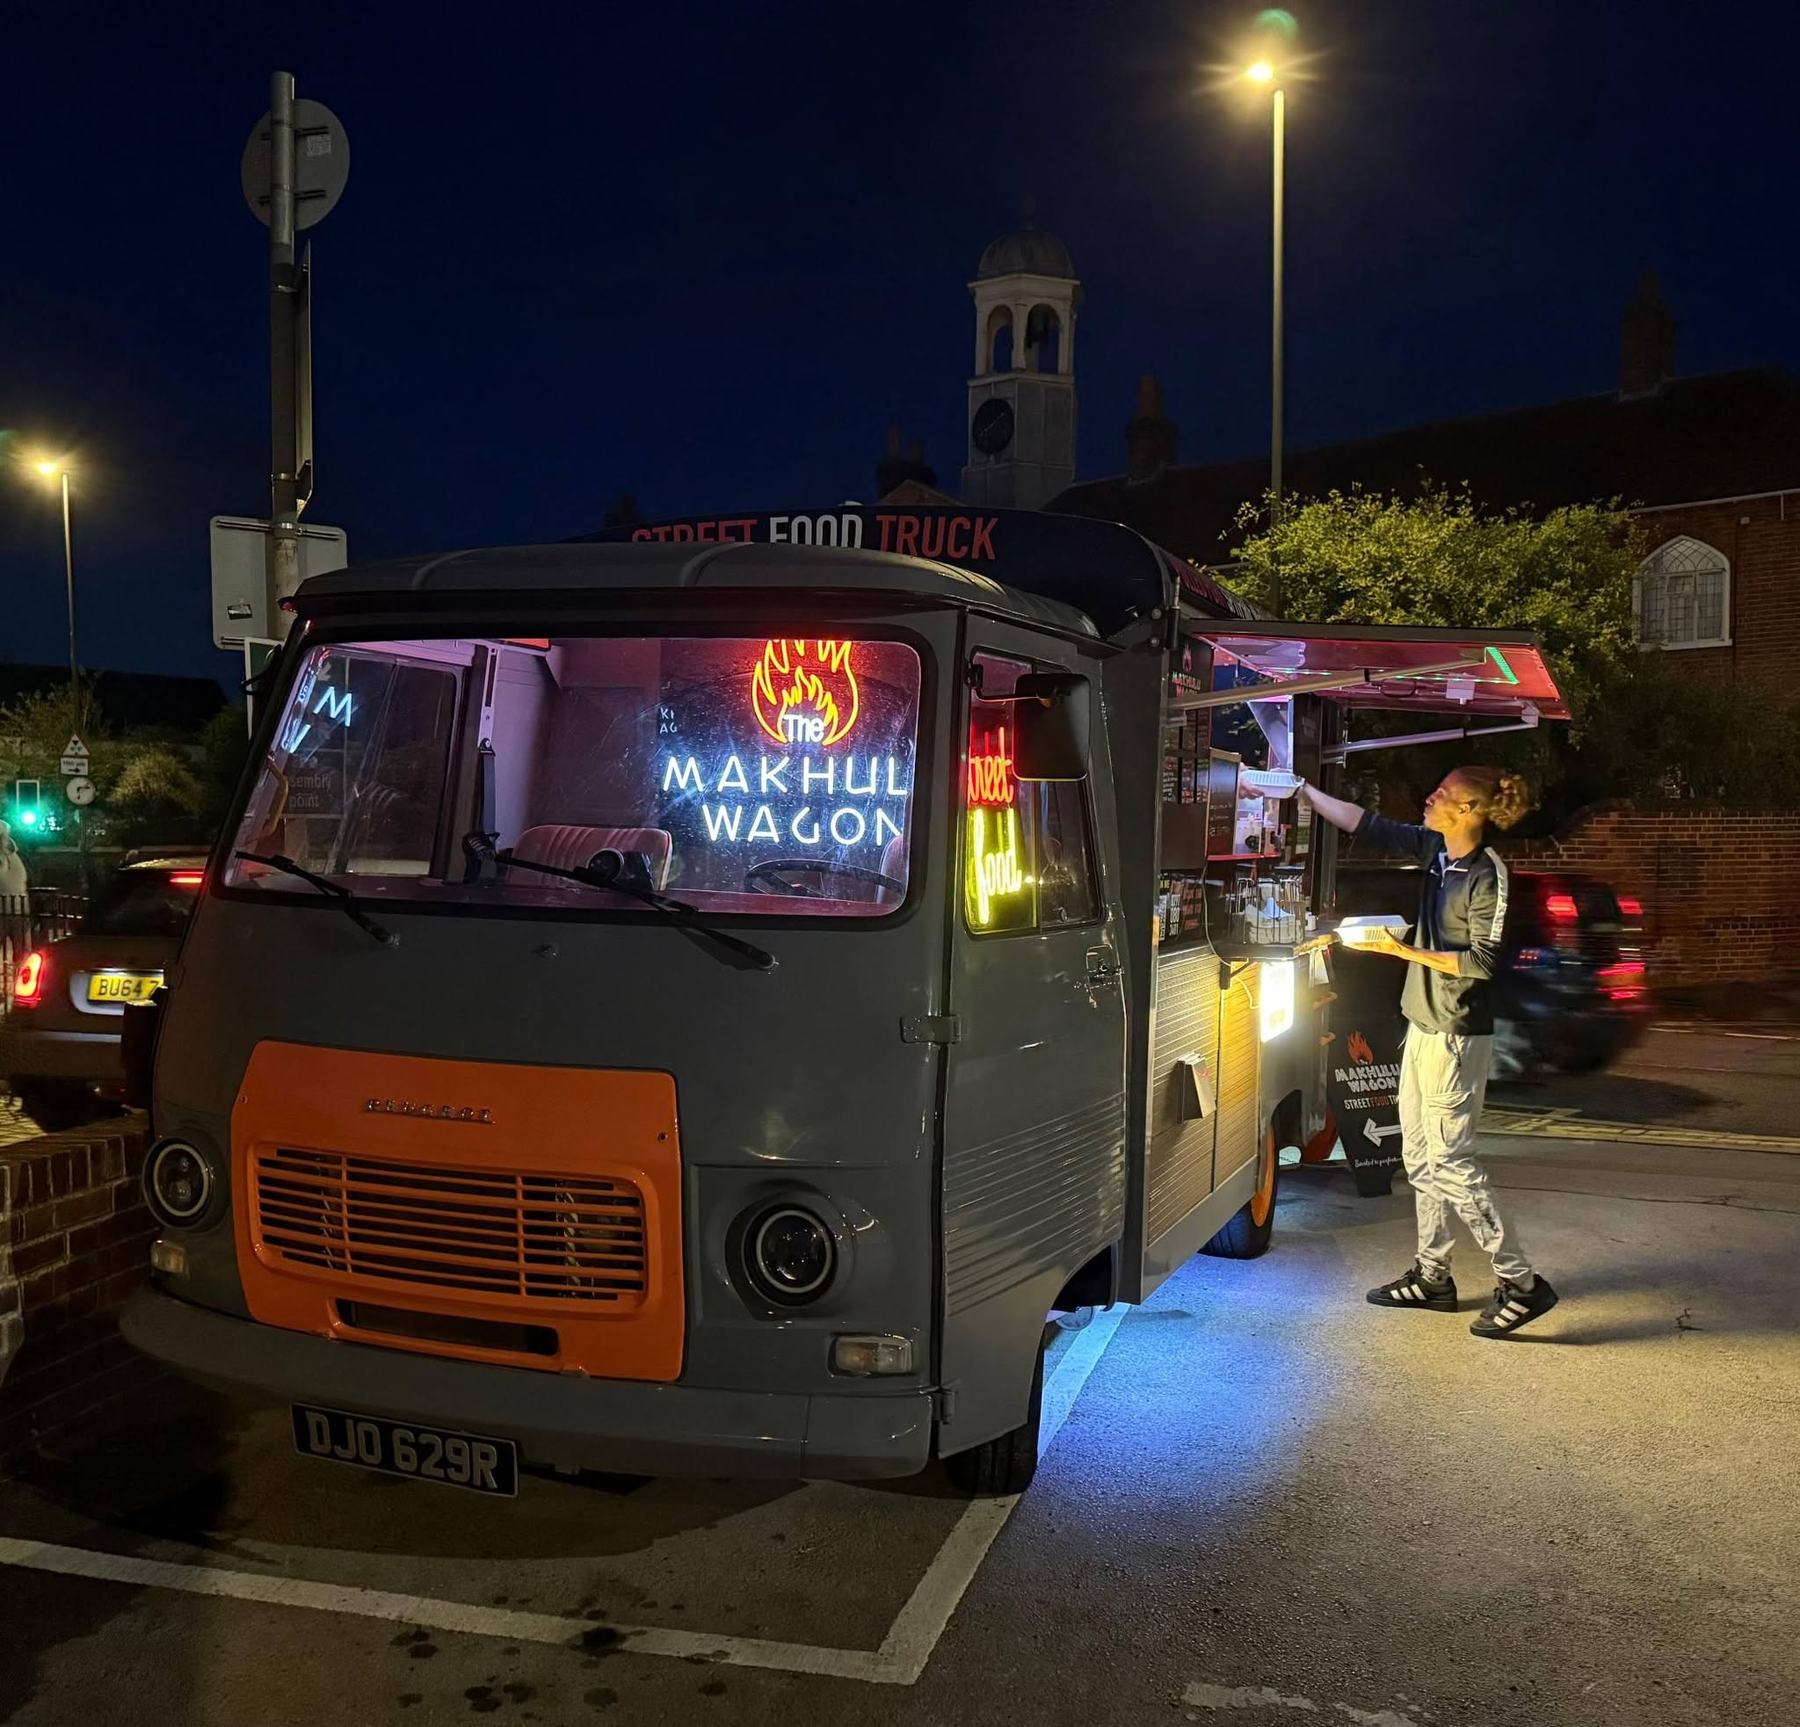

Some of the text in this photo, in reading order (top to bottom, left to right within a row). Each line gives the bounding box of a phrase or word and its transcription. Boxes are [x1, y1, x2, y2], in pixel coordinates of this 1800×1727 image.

[876, 515, 999, 560] TRUCK
[783, 714, 824, 743] The
[702, 805, 903, 846] WAGON
[972, 808, 1023, 924] food
[98, 978, 144, 997] BU64
[1335, 1064, 1400, 1082] MAKHULU
[1347, 1077, 1397, 1093] WAGON
[305, 1410, 498, 1489] DJO 629R
